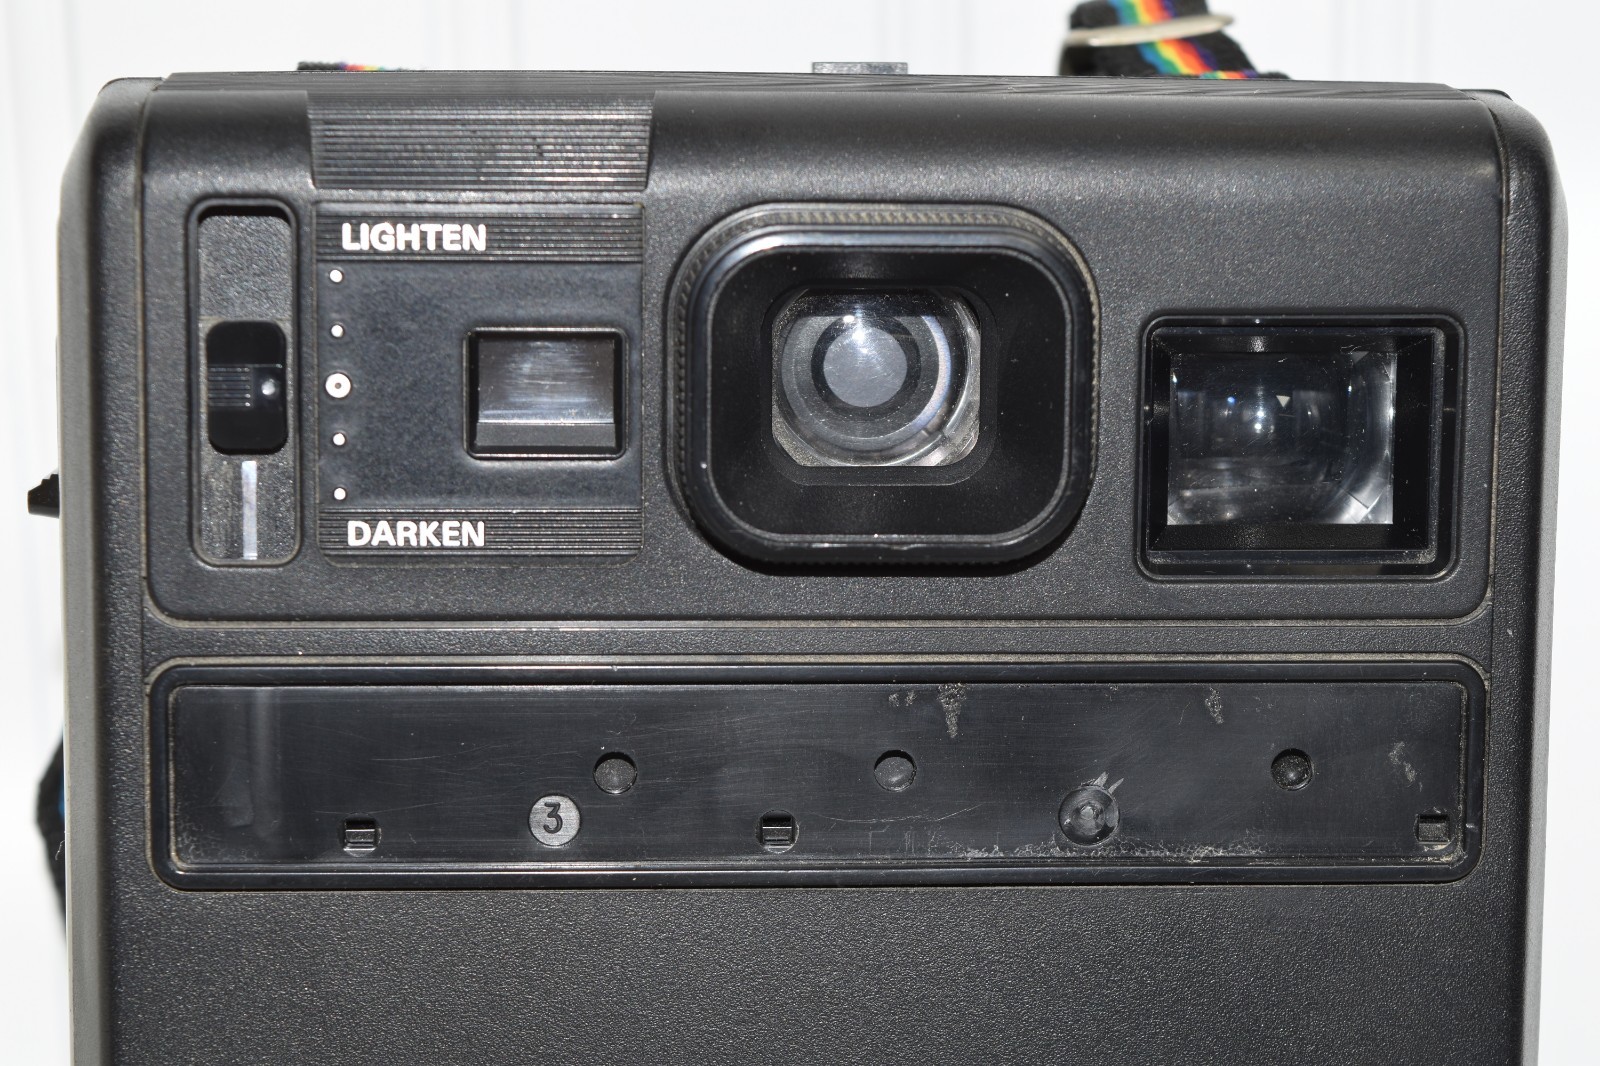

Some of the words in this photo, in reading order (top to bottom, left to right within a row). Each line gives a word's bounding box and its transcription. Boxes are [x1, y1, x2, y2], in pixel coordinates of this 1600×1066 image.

[341, 222, 487, 252] LIGHTEN
[347, 520, 485, 548] DARKEN
[543, 802, 563, 834] 3
